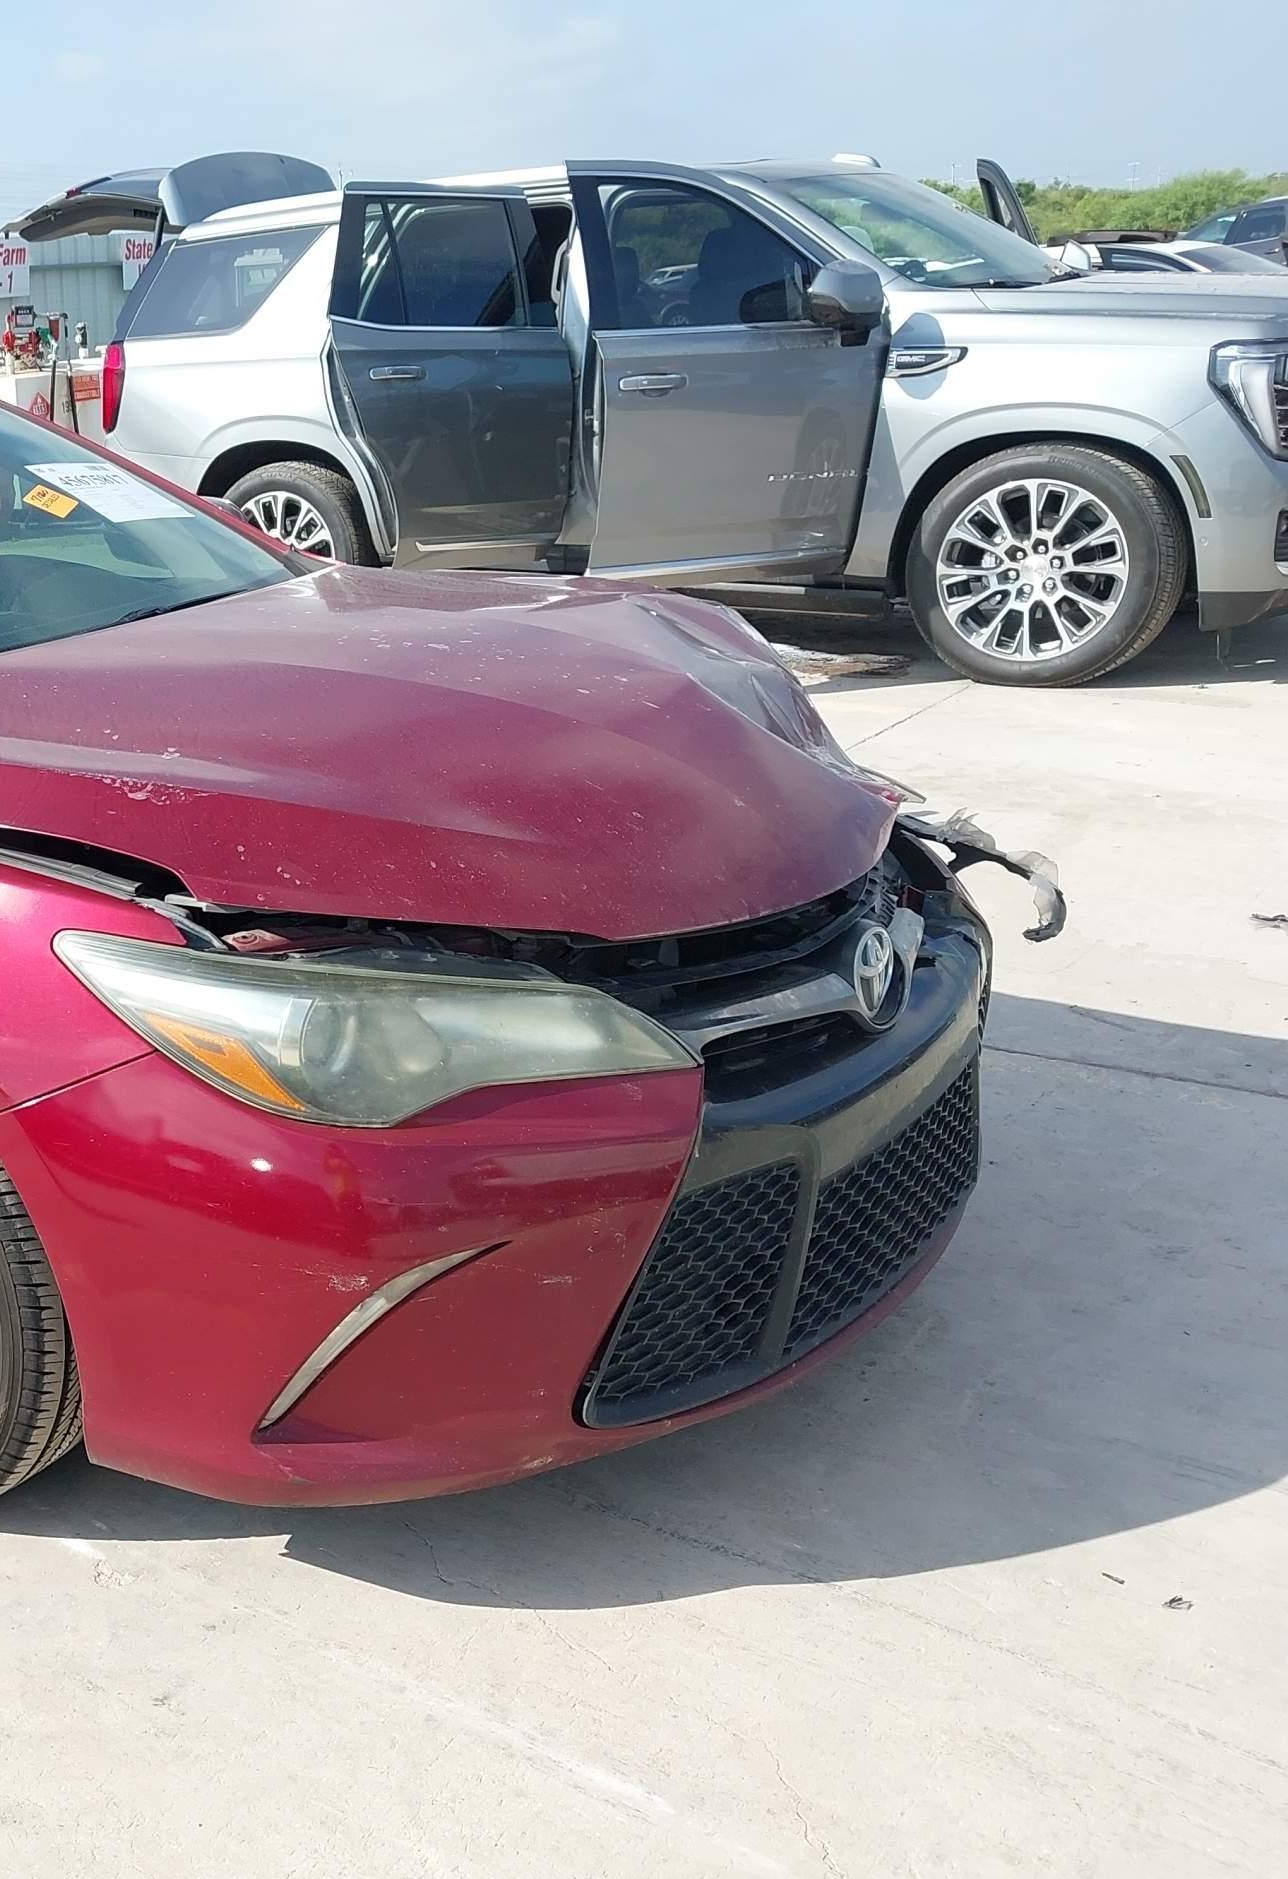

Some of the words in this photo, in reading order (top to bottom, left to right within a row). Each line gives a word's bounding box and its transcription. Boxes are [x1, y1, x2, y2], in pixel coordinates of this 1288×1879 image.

[125, 238, 153, 261] State
[7, 270, 14, 294] 1
[896, 355, 926, 363] GMC
